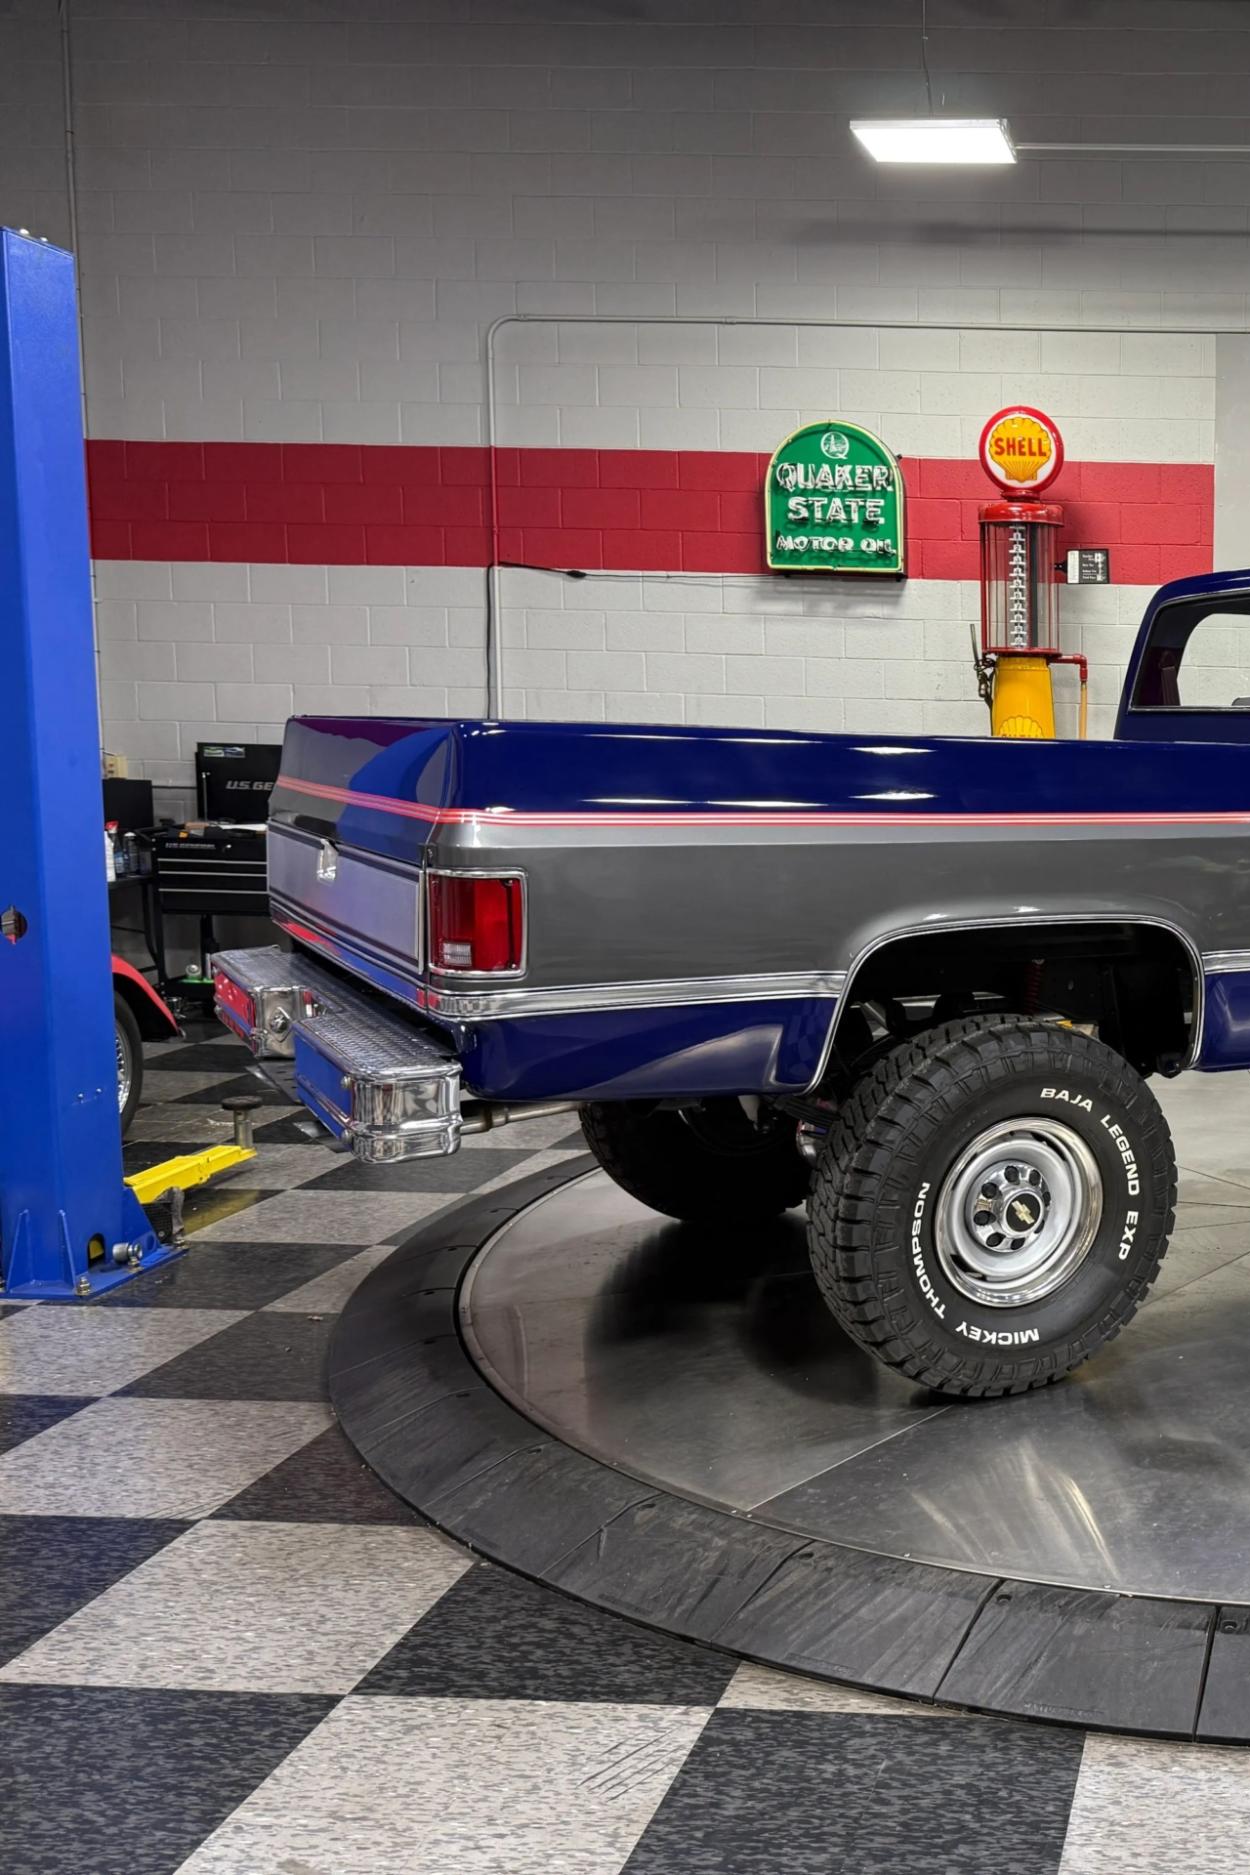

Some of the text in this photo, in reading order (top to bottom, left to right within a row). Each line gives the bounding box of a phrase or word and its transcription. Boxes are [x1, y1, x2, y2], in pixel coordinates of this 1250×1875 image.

[994, 437, 1047, 457] SHELL
[776, 462, 894, 492] QUAKER
[787, 496, 885, 524] STATE
[776, 535, 897, 554] MOTOR OIL
[1040, 1088, 1140, 1260] BAJA LEGEND EXP
[911, 1182, 1040, 1345] MICKEY THOMPSON
